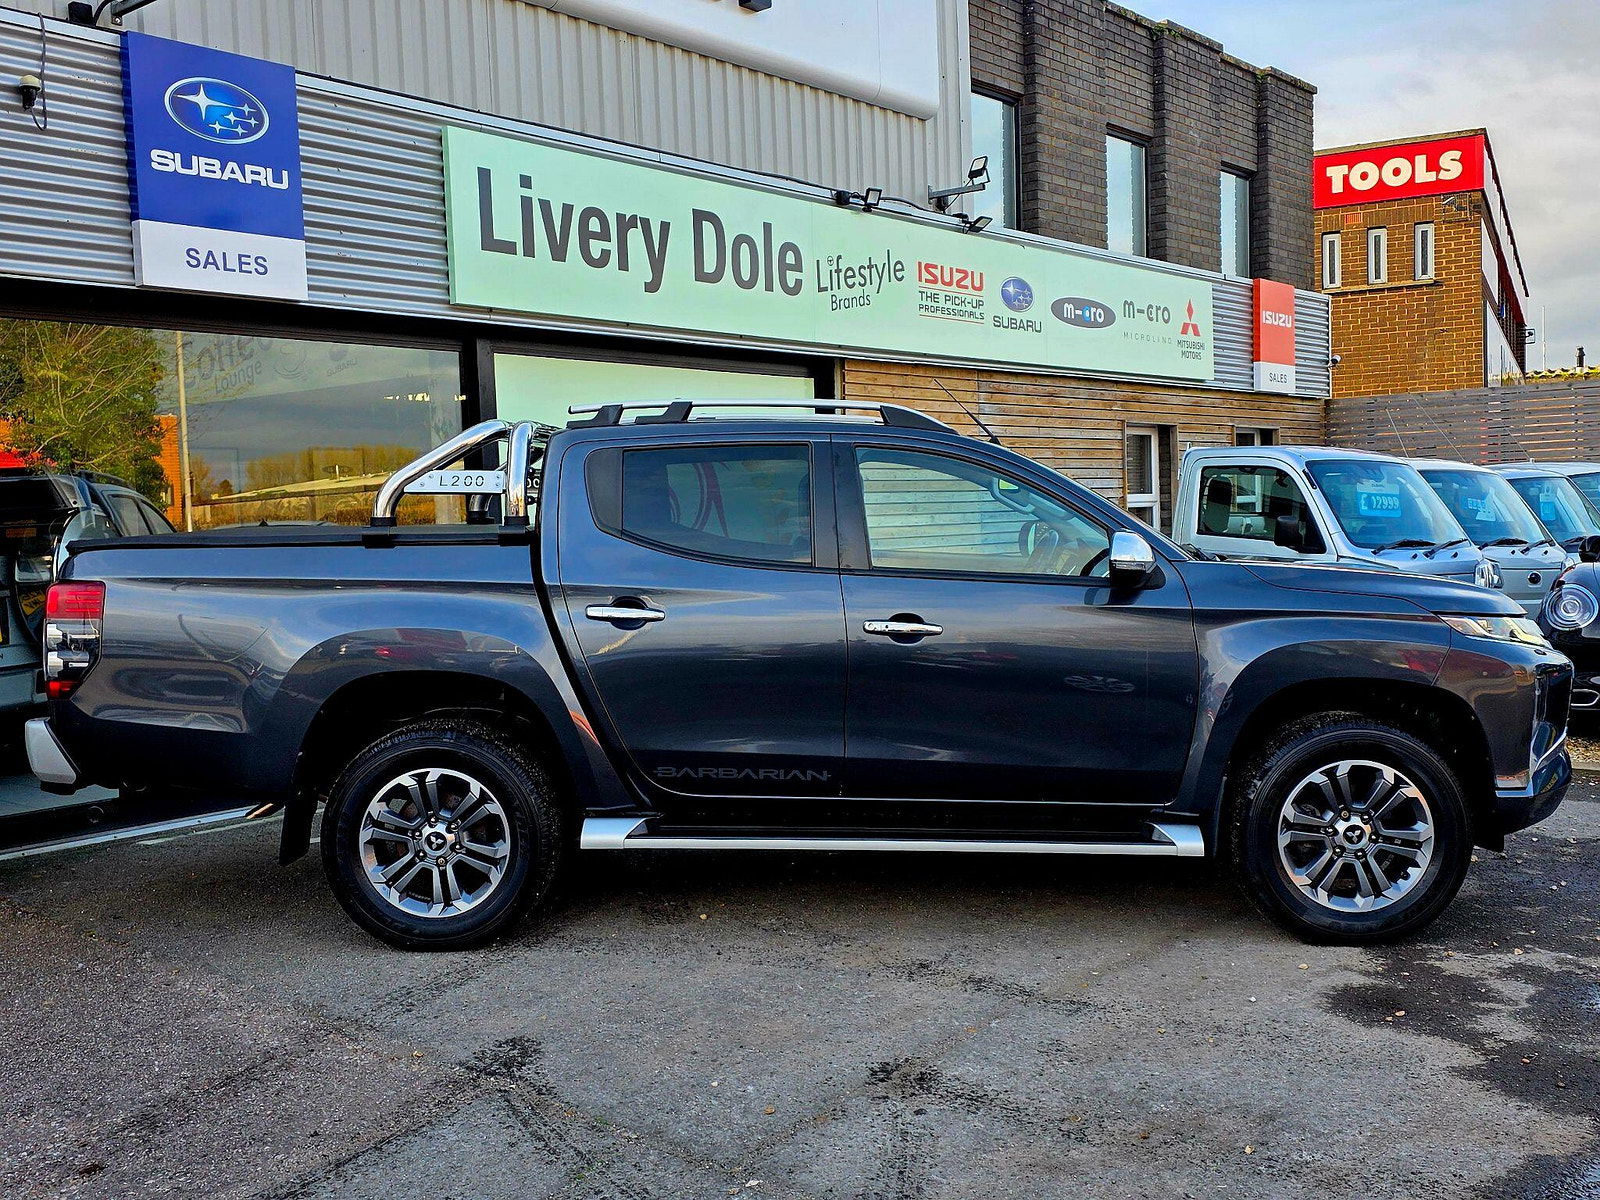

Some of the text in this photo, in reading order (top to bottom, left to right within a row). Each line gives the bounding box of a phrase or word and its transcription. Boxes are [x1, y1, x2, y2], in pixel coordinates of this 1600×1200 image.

[150, 149, 289, 190] SUBARU
[1326, 150, 1463, 194] TOOLS
[476, 166, 803, 297] Livery Dole
[185, 247, 269, 275] SALES
[816, 249, 905, 293] Lifestyle
[917, 261, 984, 291] ISUZU
[830, 289, 871, 311] Brands
[918, 290, 984, 310] THE PICK-UP
[918, 304, 985, 320] PROFESSIONALS
[1262, 310, 1292, 328] ISUZU
[992, 315, 1042, 333] SUBARU
[1177, 339, 1205, 351] MITSUBISHI
[1181, 350, 1202, 360] MOTORS
[214, 360, 263, 394] Lounge
[1269, 372, 1288, 384] SALES
[439, 475, 485, 487] L200
[654, 765, 830, 782] BARBARIAN
